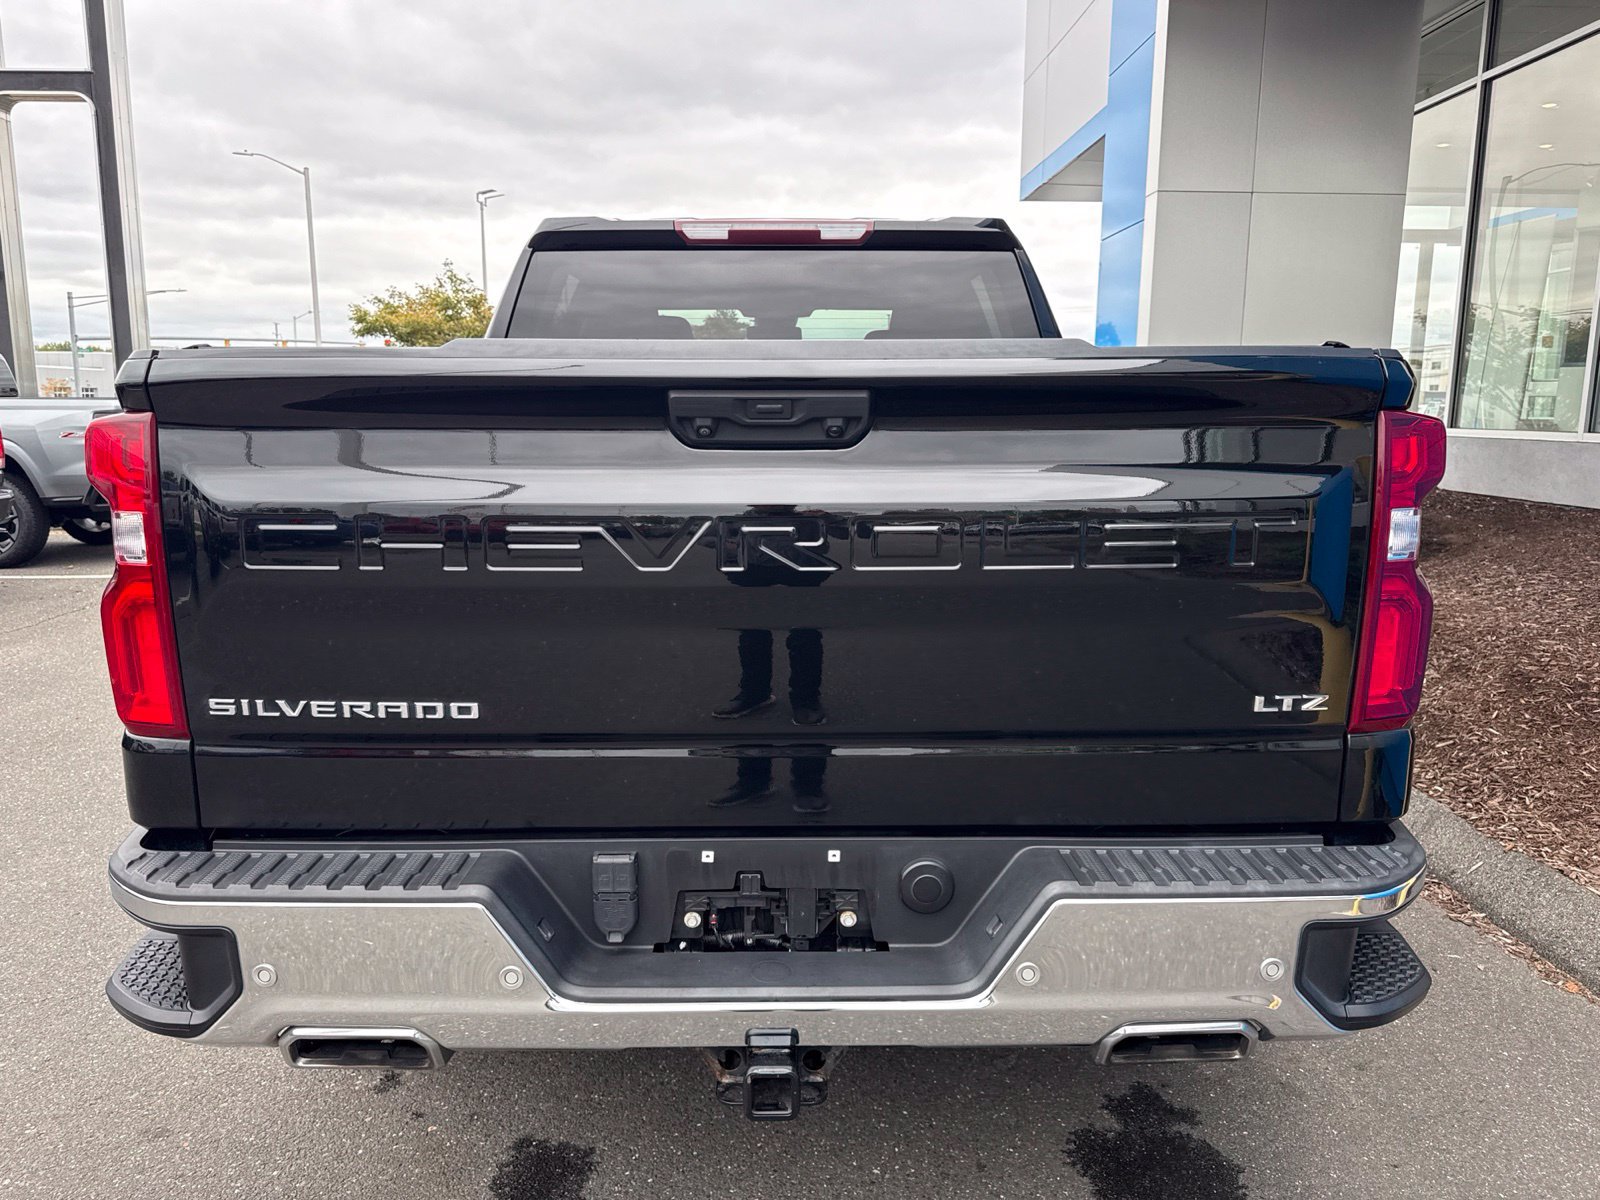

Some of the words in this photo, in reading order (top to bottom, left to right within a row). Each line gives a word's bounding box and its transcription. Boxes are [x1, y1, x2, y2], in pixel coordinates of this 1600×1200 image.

[240, 512, 1298, 572] CHEVROLET
[208, 698, 480, 720] SILVERADO
[1253, 694, 1330, 713] LTZ
